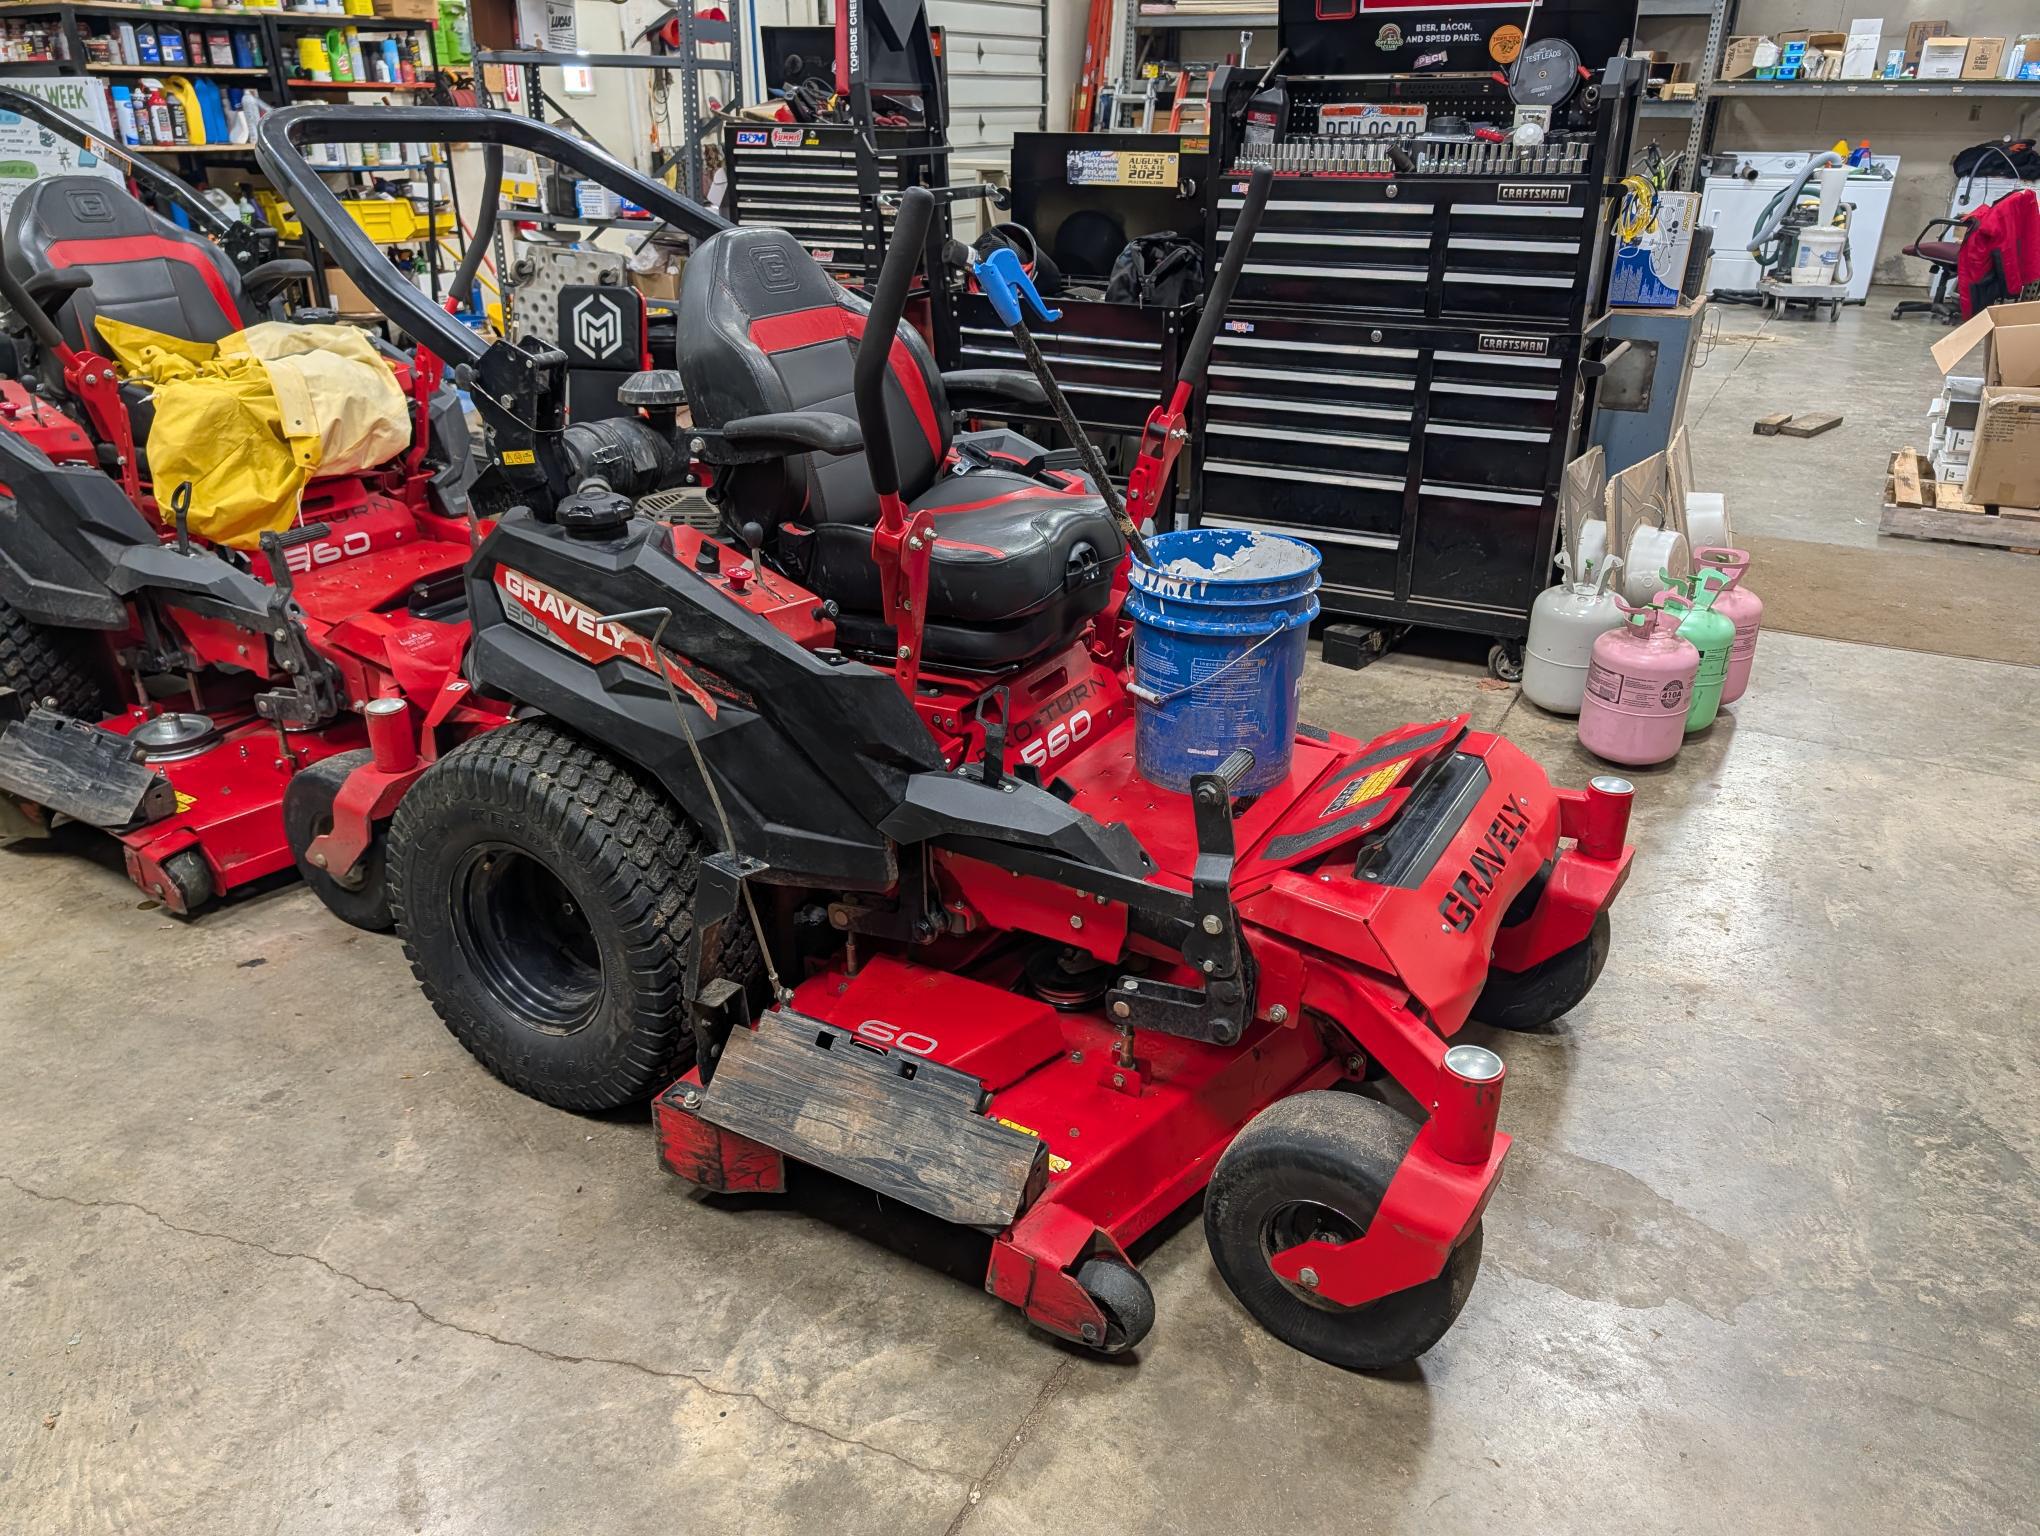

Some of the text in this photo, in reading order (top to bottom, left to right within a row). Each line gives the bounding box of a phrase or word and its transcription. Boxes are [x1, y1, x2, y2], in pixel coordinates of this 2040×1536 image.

[551, 15, 572, 28] LUCAS
[1415, 22, 1473, 32] BEER, BACON,
[1405, 33, 1482, 43] AND SPEED PARTS.
[850, 27, 859, 74] TOPSIDE
[1525, 49, 1562, 62] TEST LEADS
[44, 84, 88, 109] WEEK
[1128, 170, 1164, 180] 2025
[1502, 188, 1565, 199] CRAFTSMAN
[1483, 338, 1544, 352] CRAFTSMAN
[505, 571, 625, 651] GRAVELY
[507, 601, 552, 636] 500
[1661, 690, 1682, 699] 410A
[1020, 709, 1092, 768] 560
[1438, 793, 1531, 934] GRAVELY
[857, 1019, 938, 1055] 60
